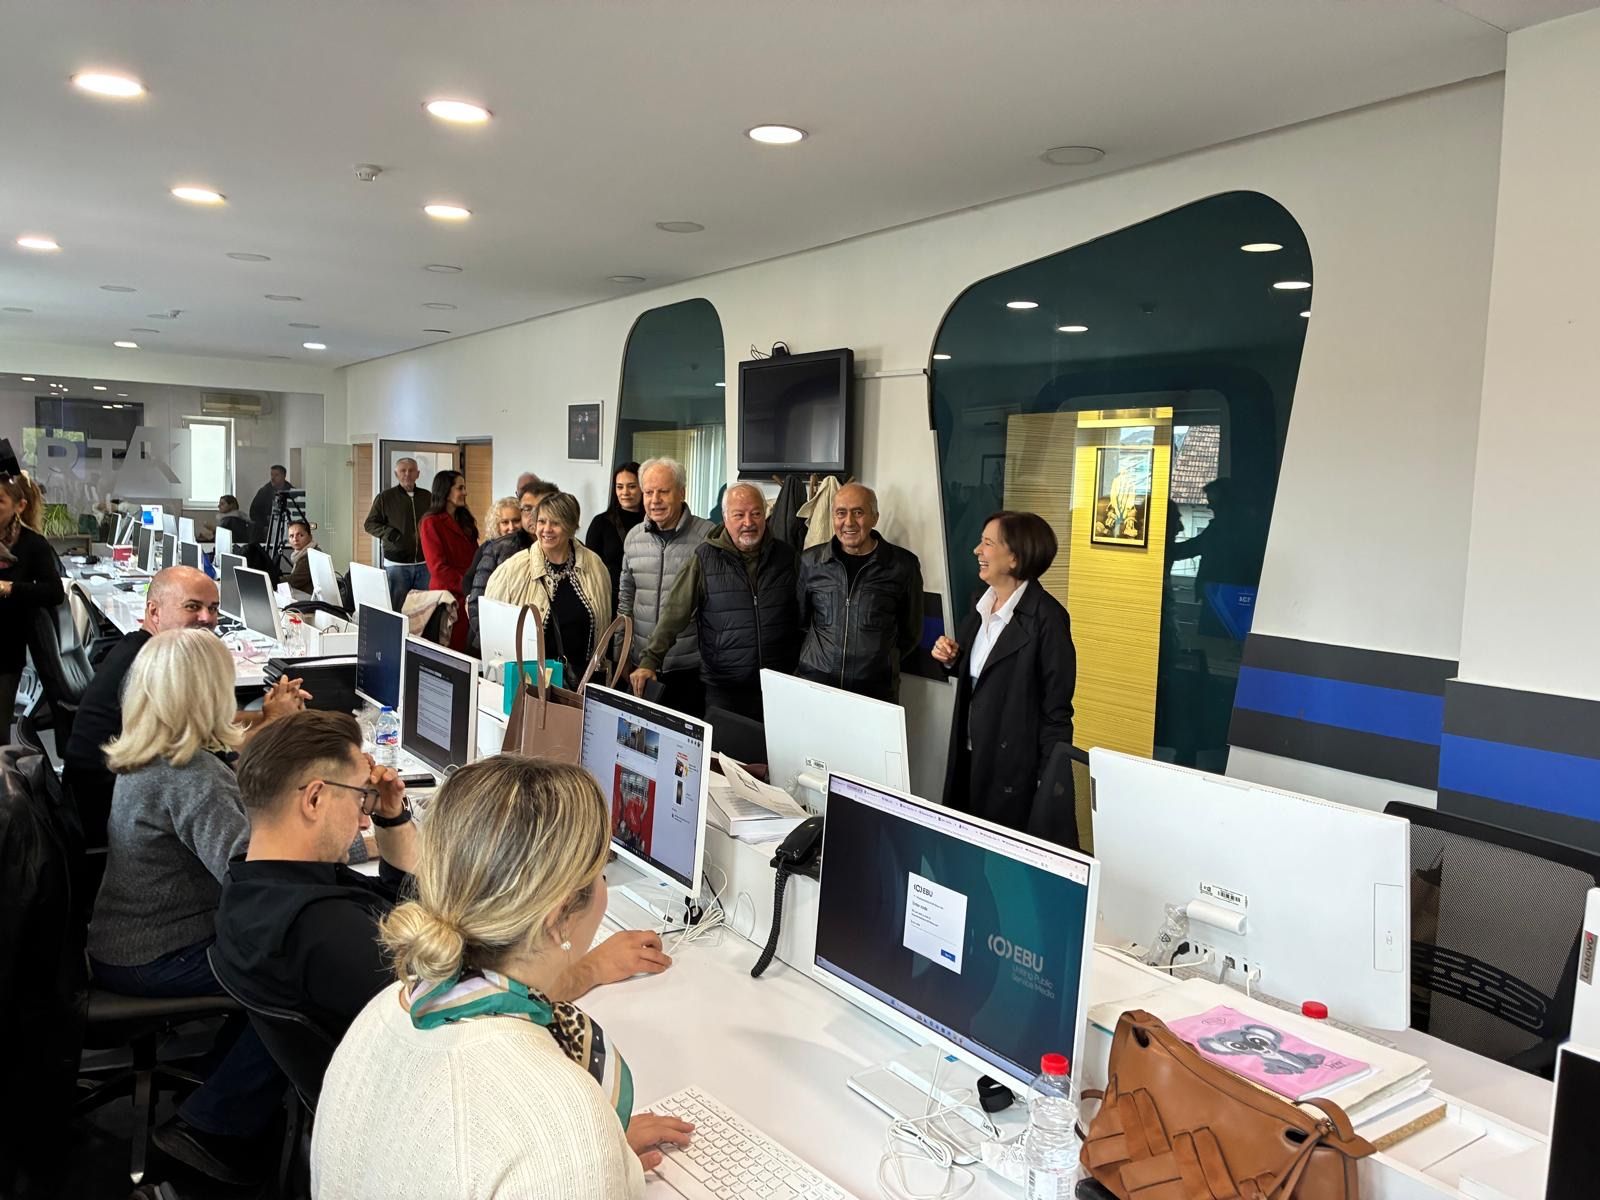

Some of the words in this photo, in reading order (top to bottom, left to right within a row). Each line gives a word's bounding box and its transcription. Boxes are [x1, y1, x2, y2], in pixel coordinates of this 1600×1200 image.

[923, 887, 933, 897] EBU
[1013, 945, 1043, 973] EBU
[1582, 935, 1593, 979] Lenovo
